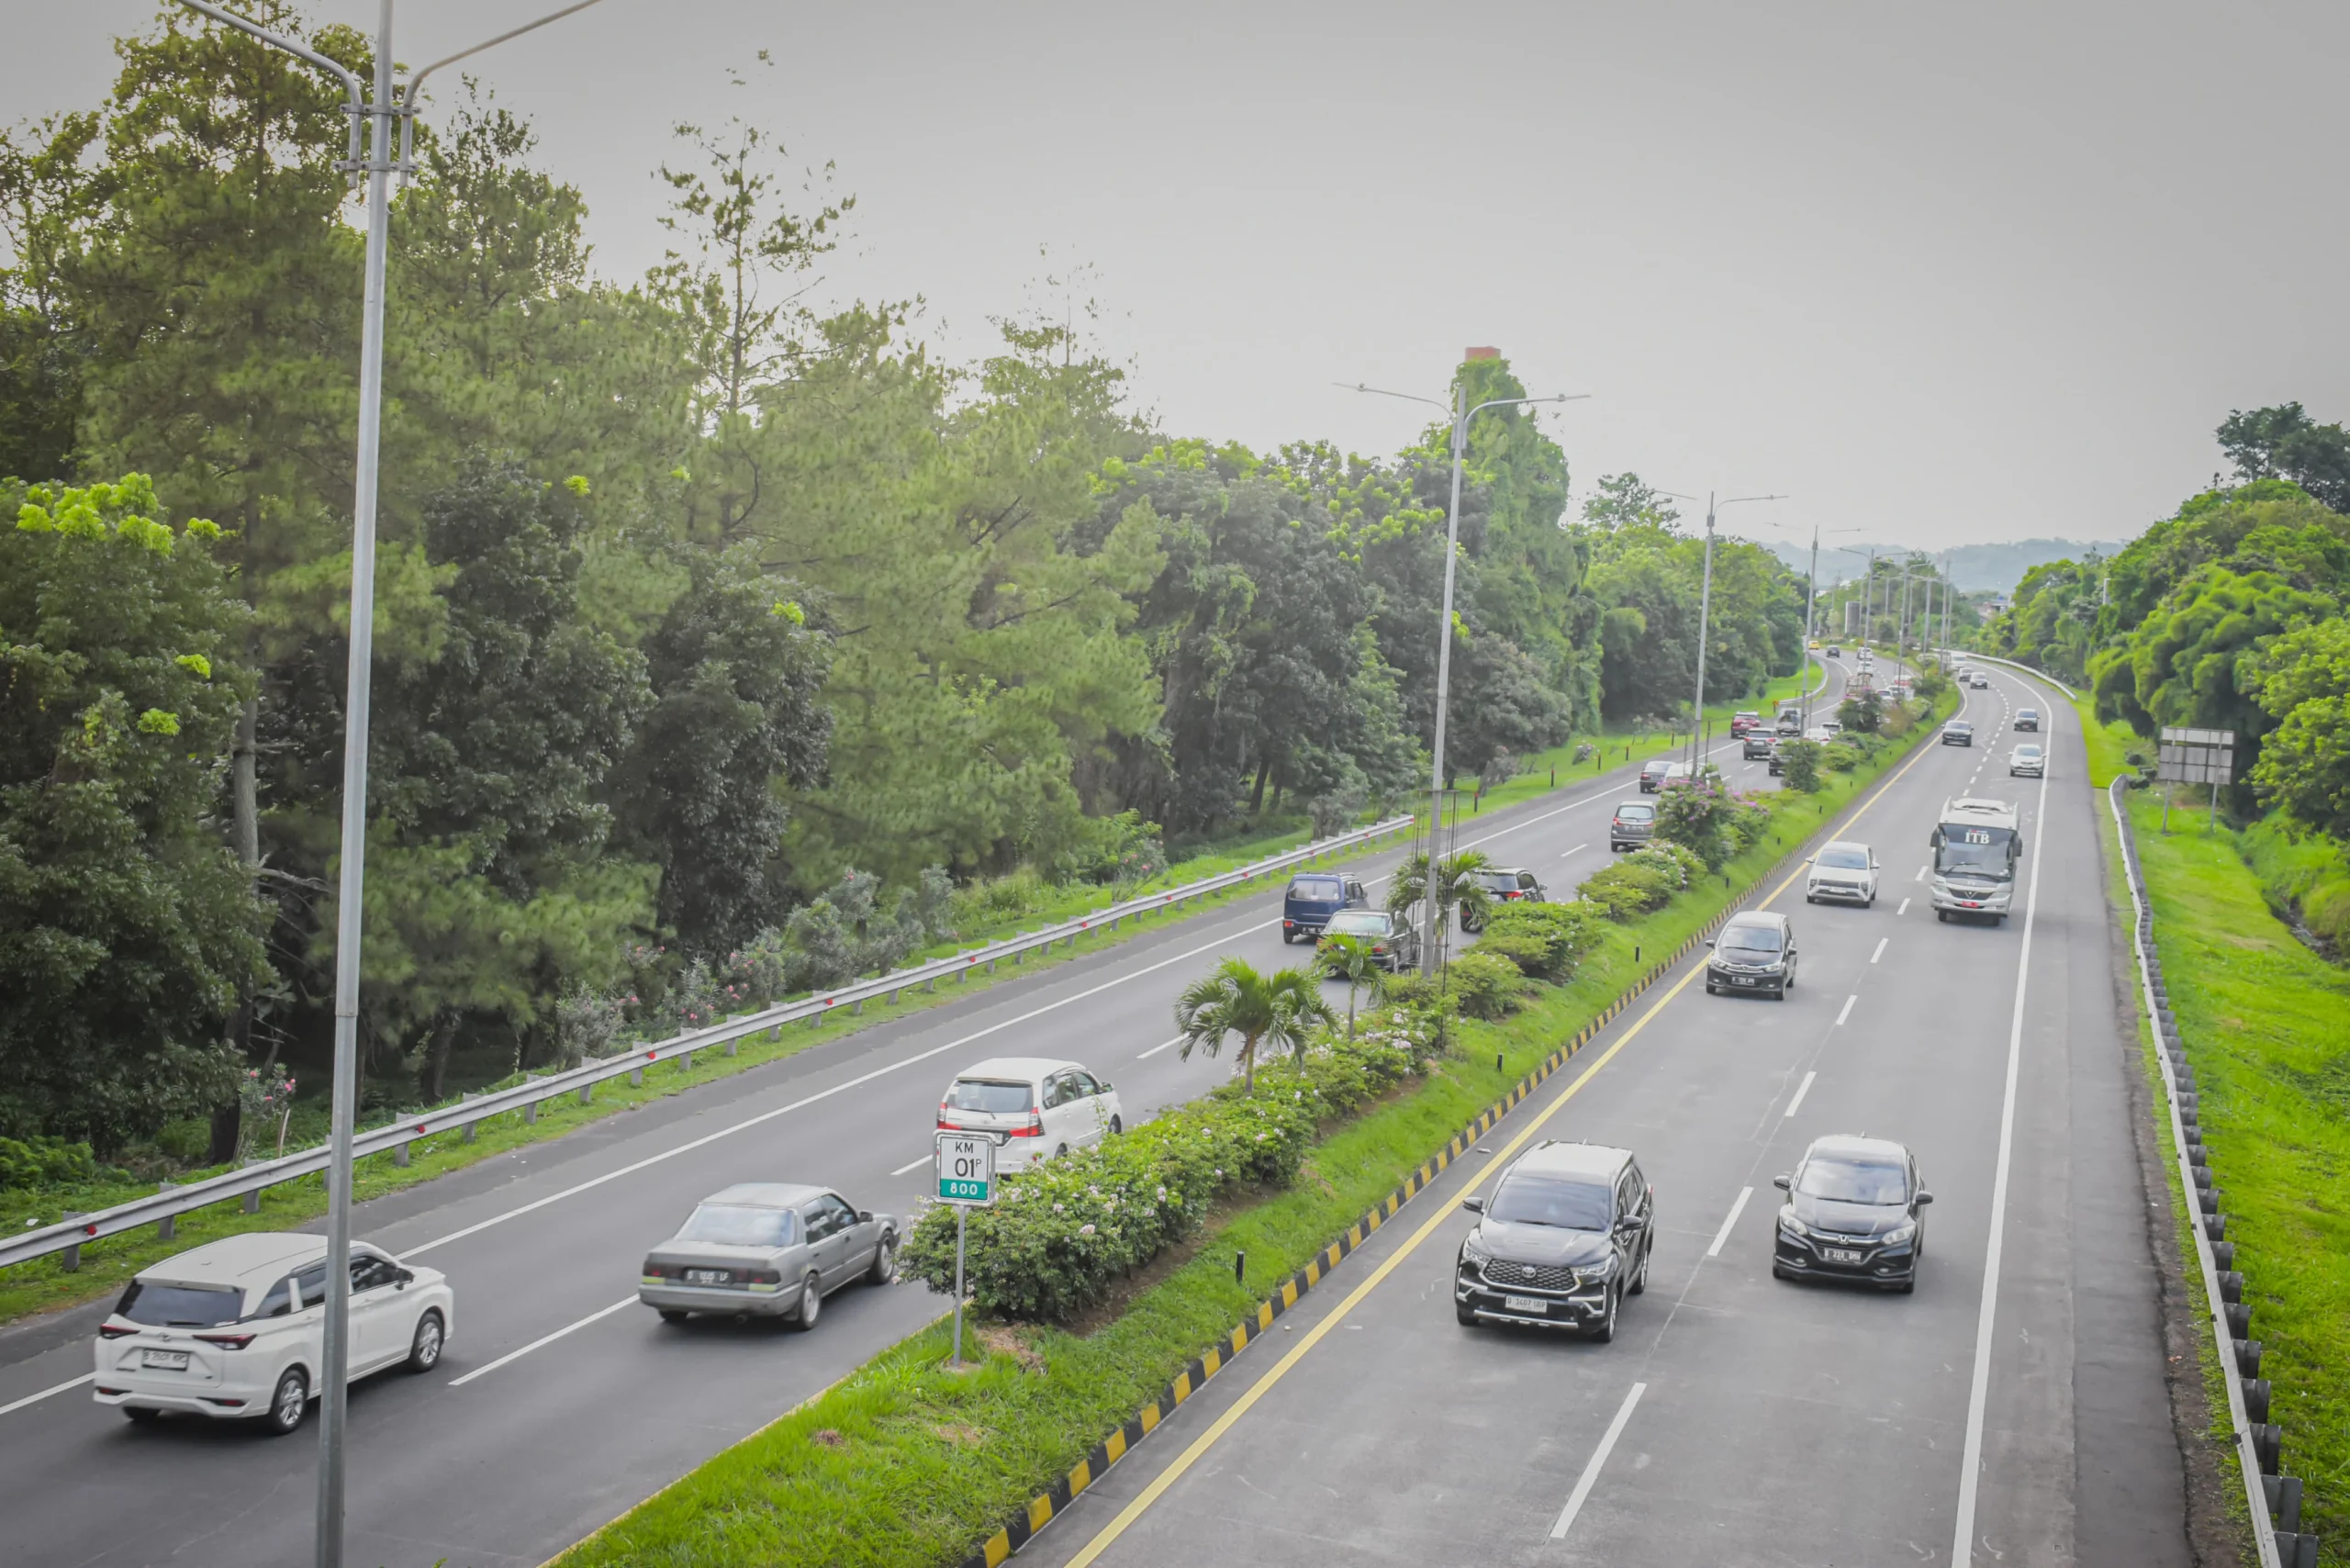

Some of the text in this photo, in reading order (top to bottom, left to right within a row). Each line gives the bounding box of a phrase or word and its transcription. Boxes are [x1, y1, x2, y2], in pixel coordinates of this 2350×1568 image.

[1964, 832, 1990, 844] ITB
[955, 1141, 974, 1154] KM
[950, 1182, 978, 1195] 800
